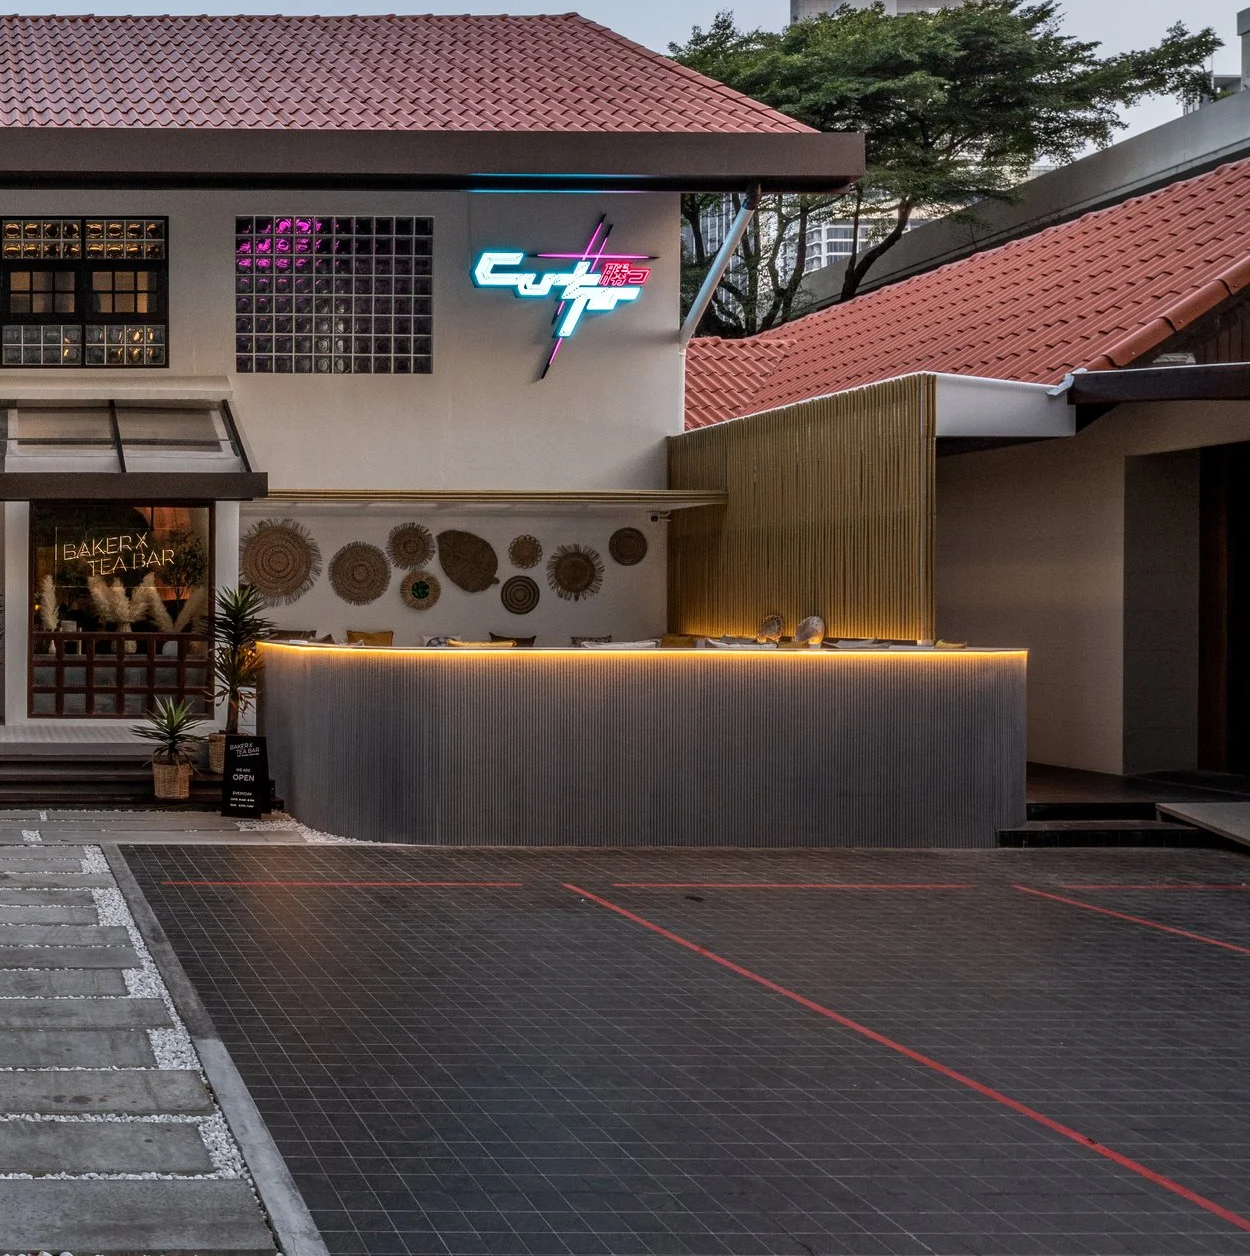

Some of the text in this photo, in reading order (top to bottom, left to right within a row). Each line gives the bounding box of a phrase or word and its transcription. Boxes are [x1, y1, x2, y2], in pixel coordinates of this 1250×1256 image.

[87, 548, 175, 577] TEA BAR
[232, 774, 255, 782] OPEN
